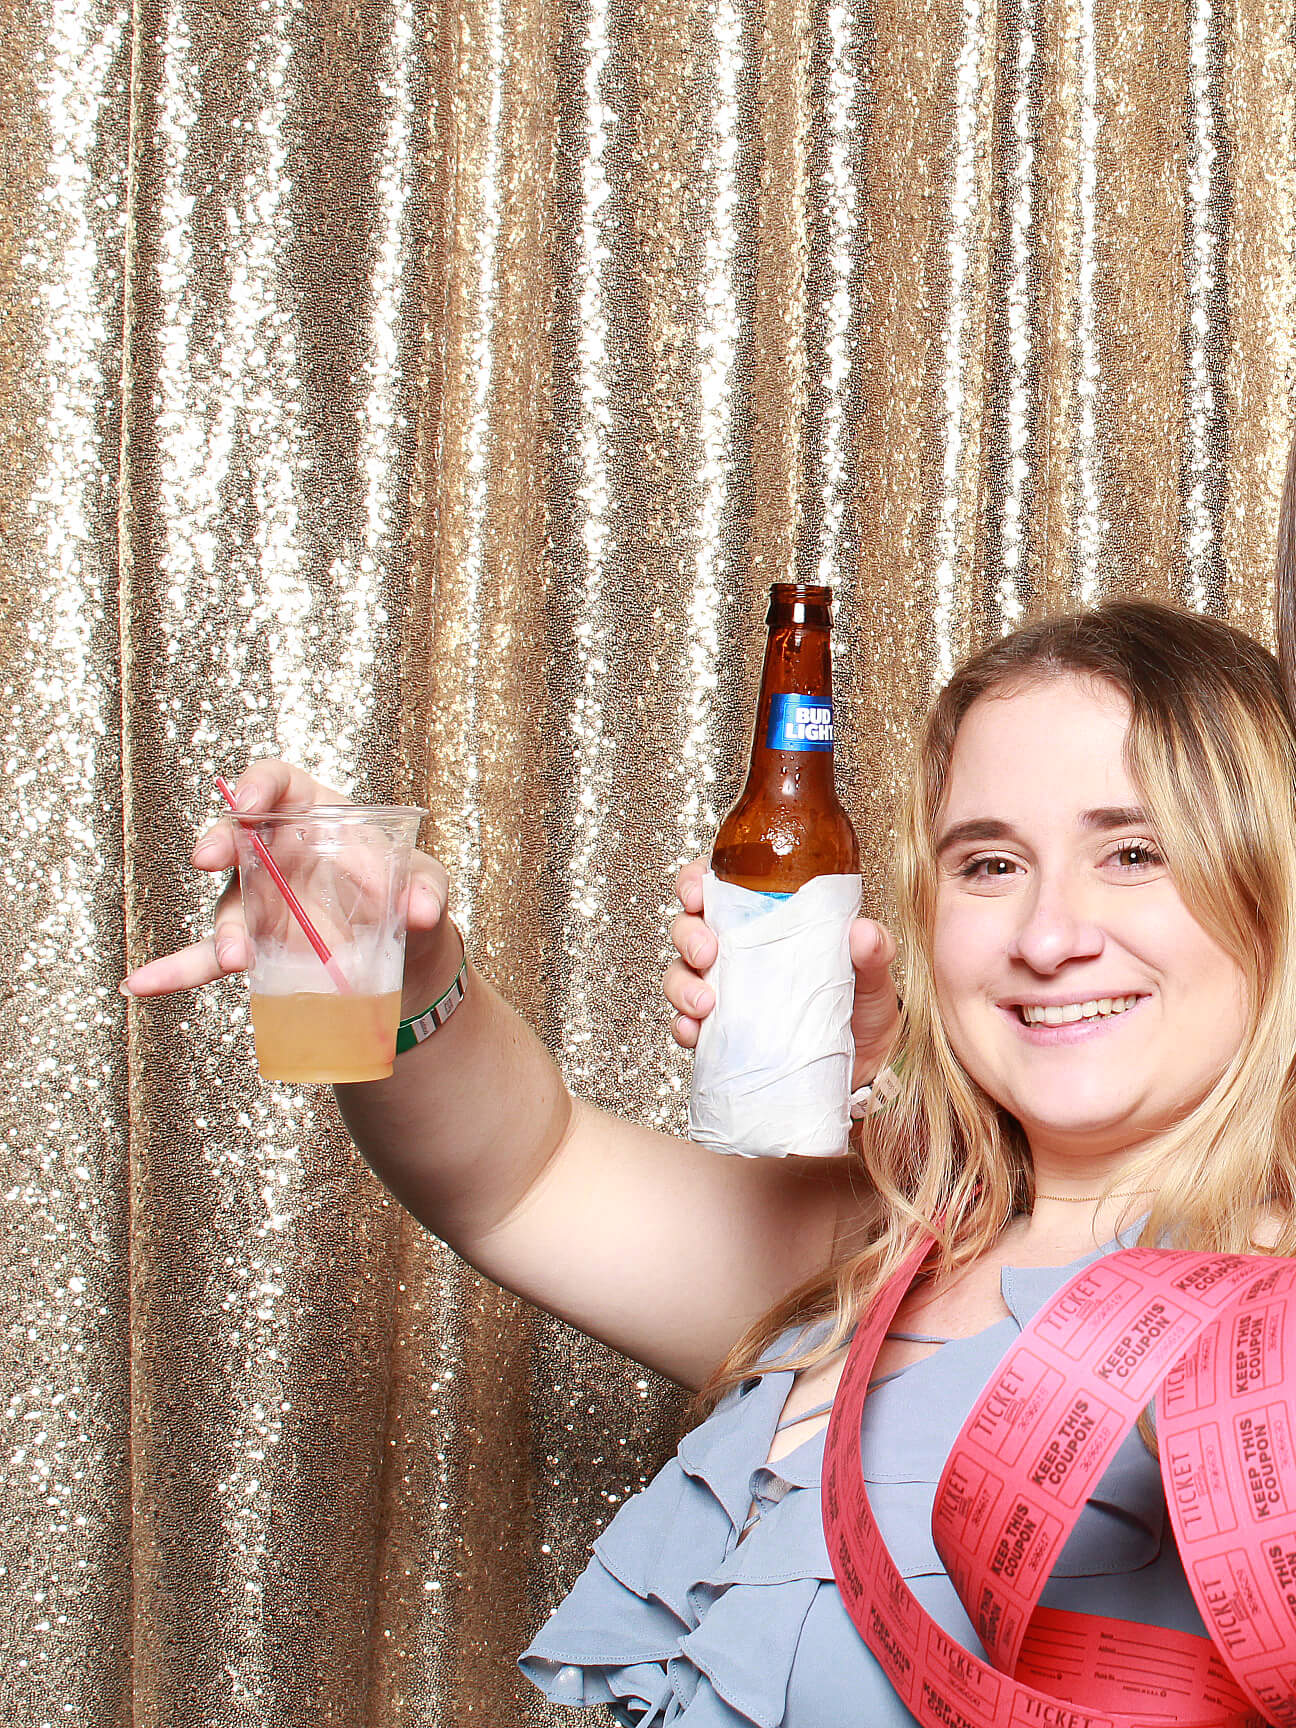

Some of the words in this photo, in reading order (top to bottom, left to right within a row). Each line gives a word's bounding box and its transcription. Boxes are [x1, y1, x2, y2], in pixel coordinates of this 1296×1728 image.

[796, 708, 831, 724] BUD
[1045, 1276, 1102, 1330] TICKET
[1176, 1263, 1211, 1290] KEEP
[1098, 1336, 1132, 1379] KEEP
[1131, 1303, 1166, 1335] THIS
[1115, 1315, 1171, 1378] COUPON
[1237, 1315, 1251, 1347] THIS
[1249, 1318, 1263, 1380] COUPON
[1168, 1352, 1186, 1405] TICK
[1236, 1352, 1248, 1392] KEEP
[974, 1367, 1025, 1436] TICKET
[1032, 1440, 1060, 1486] KEEP
[1058, 1400, 1089, 1437] THIS
[1048, 1415, 1095, 1485] COUPON
[1240, 1418, 1257, 1462] THIS
[1254, 1424, 1280, 1503] COUPON
[938, 1469, 969, 1524] TICKET
[1172, 1453, 1202, 1527] TICKET
[1248, 1467, 1270, 1517] KEEP
[991, 1539, 1010, 1574] KEEP
[1005, 1503, 1029, 1538] THIS
[1004, 1519, 1037, 1578] COUPON
[1269, 1545, 1293, 1589] THIS
[1202, 1580, 1246, 1648] TICKET
[935, 1636, 983, 1685] TICKET
[1024, 1699, 1095, 1728] TICKET
